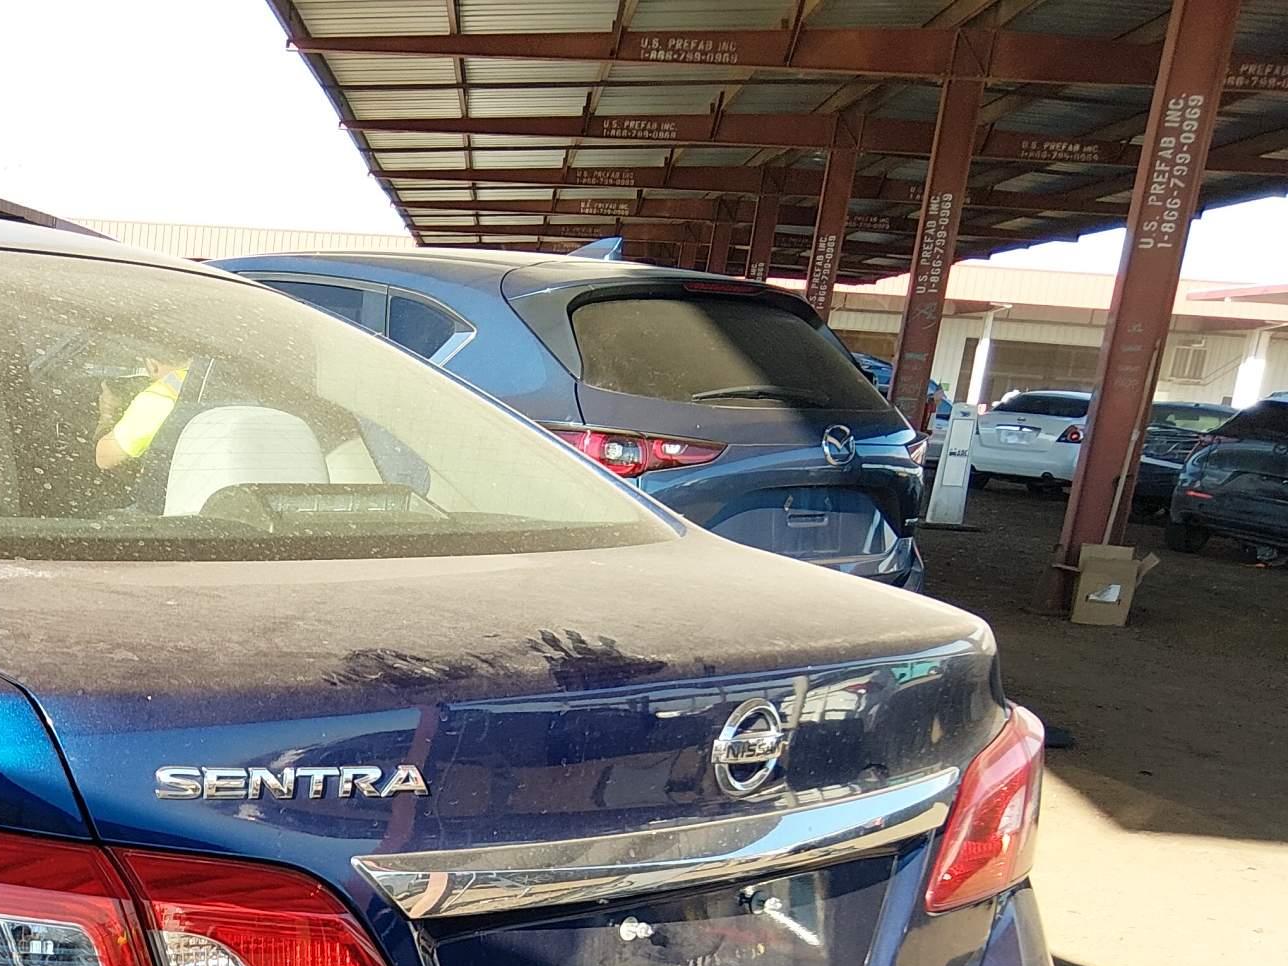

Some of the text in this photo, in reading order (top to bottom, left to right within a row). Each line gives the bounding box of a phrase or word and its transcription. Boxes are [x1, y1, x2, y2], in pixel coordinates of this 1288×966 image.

[668, 38, 713, 51] PREFAB
[1139, 92, 1187, 248] U.S. PREFAB INC.
[1157, 94, 1204, 248] 1-866-799-0969
[920, 220, 937, 265] PREFAB
[927, 193, 953, 293] 1-866-799-0969
[811, 255, 824, 289] PREFAB
[916, 271, 929, 294] U.S.
[155, 764, 432, 800] SENTRA
